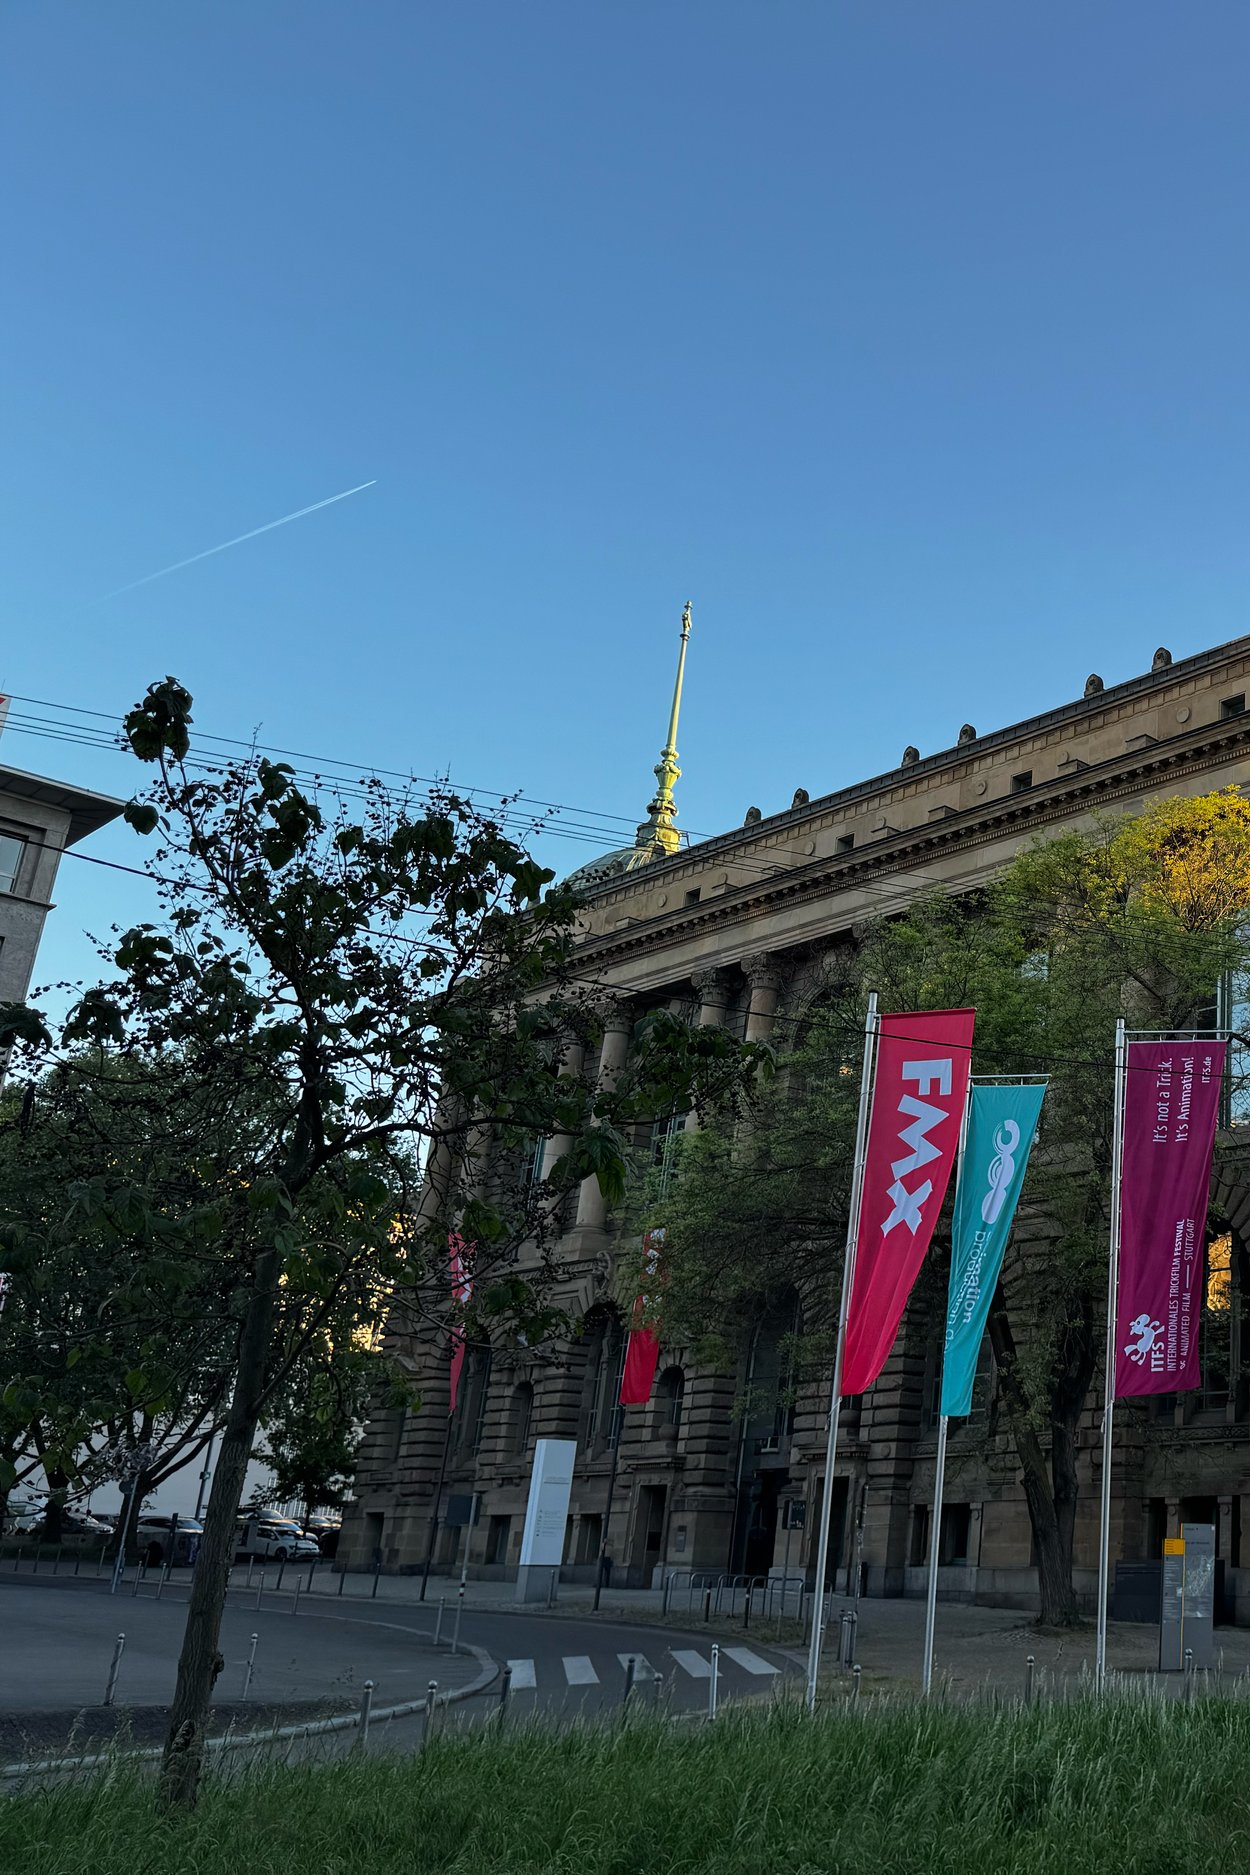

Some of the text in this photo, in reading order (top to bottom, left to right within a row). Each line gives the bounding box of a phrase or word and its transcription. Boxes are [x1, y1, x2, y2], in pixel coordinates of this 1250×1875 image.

[1157, 1101, 1170, 1122] not
[1159, 1091, 1170, 1099] a
[1175, 1056, 1195, 1142] It's Animation!
[880, 1058, 953, 1238] FMX
[1153, 1124, 1168, 1143] It's
[1184, 1218, 1196, 1261] STUTTGART
[1166, 1219, 1185, 1372] INTERNATIONALES TRICKFILM FESTIVAL
[1181, 1292, 1192, 1312] FILM
[1180, 1315, 1191, 1356] ANIMATED
[1150, 1341, 1165, 1372] ITFS
